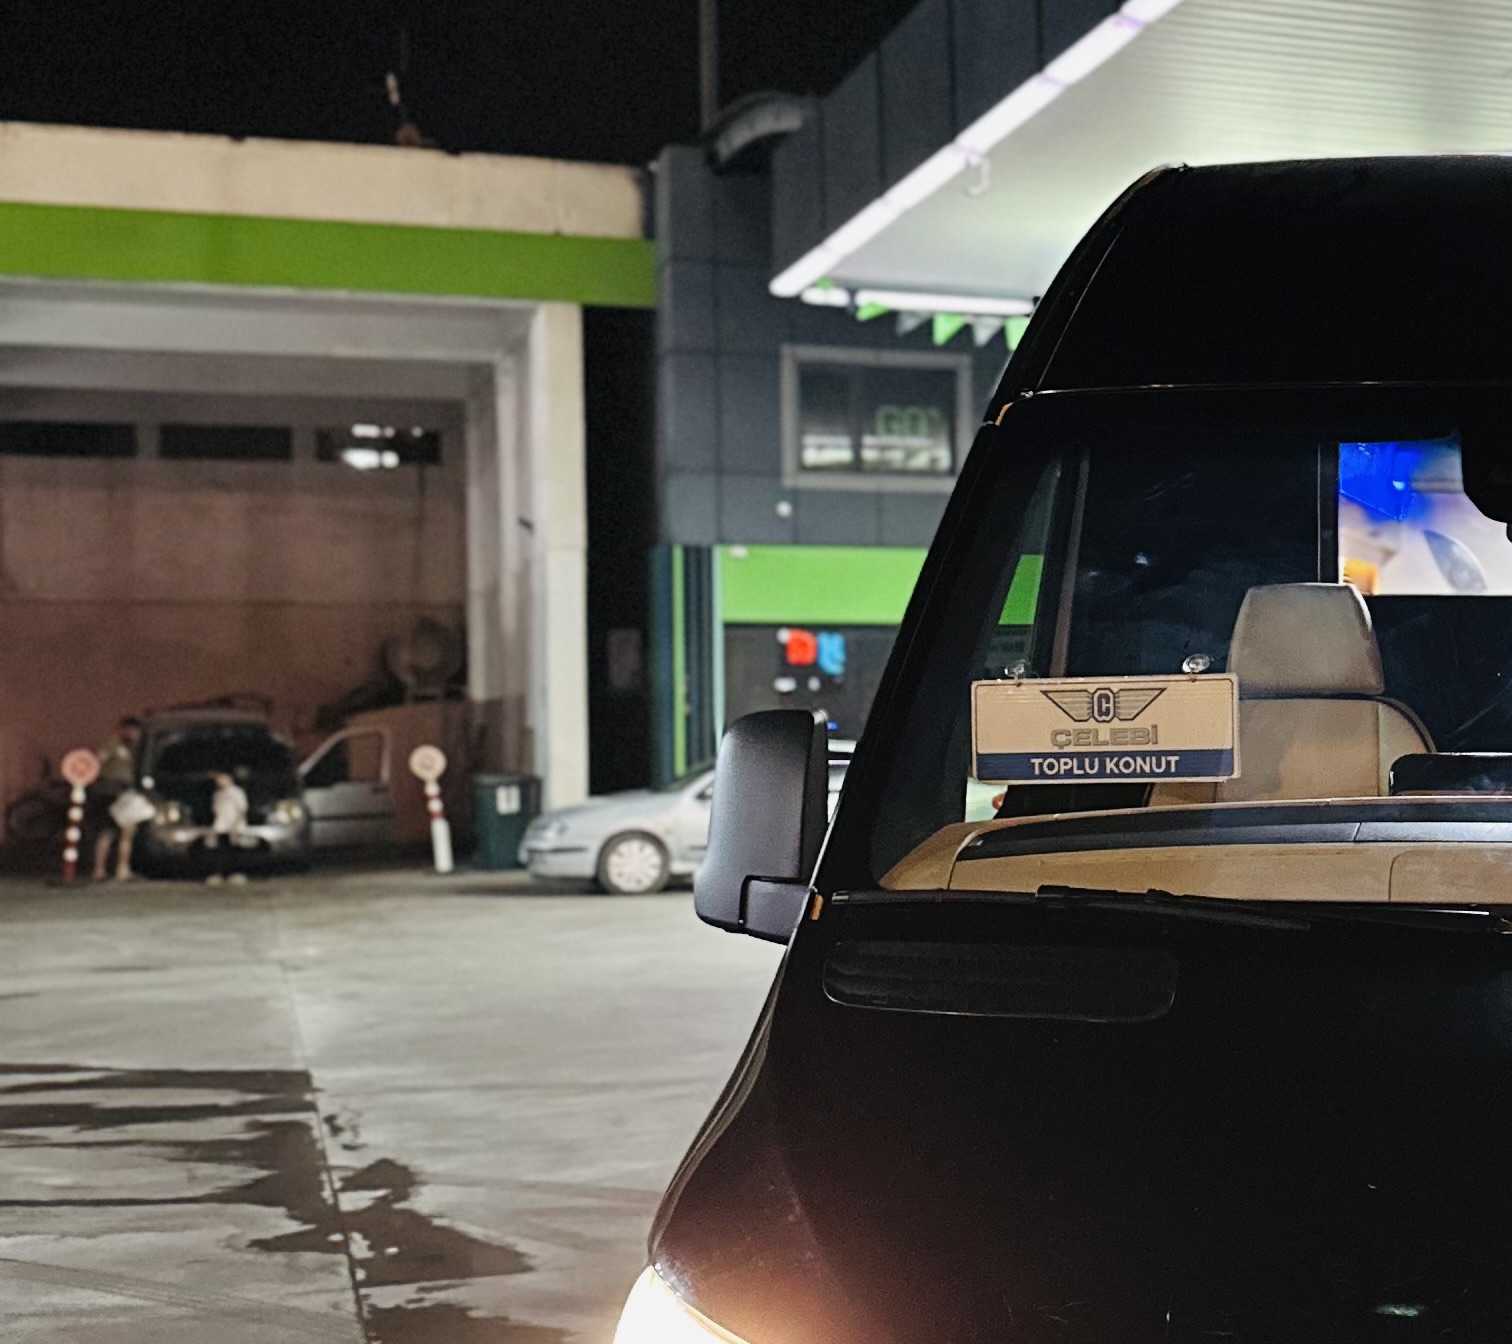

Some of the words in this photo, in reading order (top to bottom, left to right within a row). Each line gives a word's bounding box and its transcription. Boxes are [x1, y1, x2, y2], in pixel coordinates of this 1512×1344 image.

[1050, 724, 1159, 750] ÇELEBİ
[1030, 757, 1099, 776] TOPLU
[1105, 755, 1180, 774] KONUT
